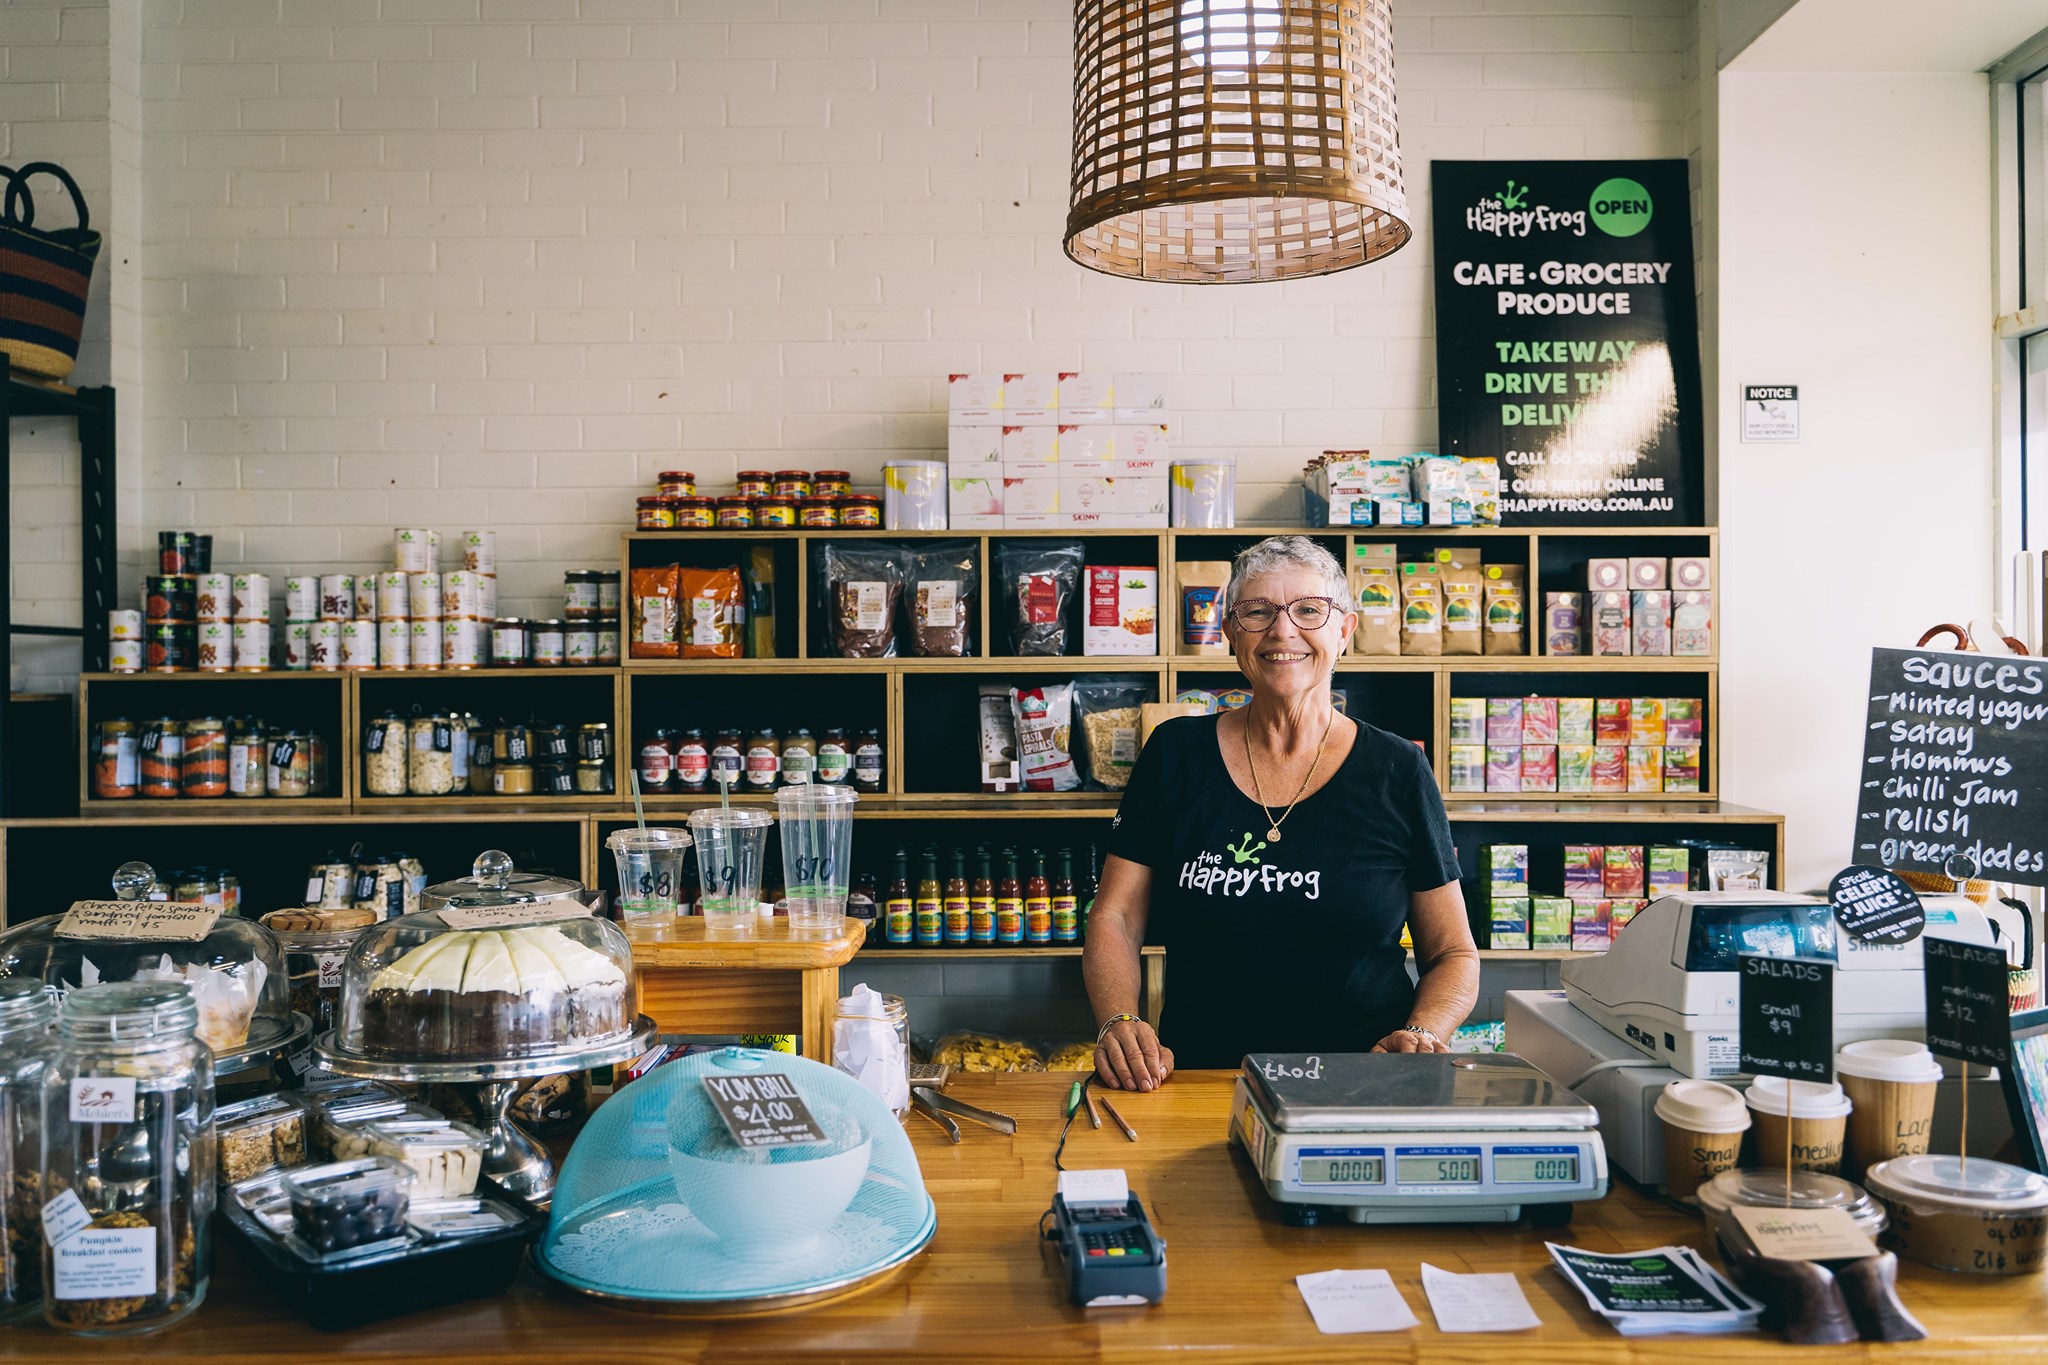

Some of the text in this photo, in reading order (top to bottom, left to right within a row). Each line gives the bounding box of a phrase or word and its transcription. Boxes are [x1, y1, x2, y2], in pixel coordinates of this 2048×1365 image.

[1479, 199, 1502, 211] the
[1594, 199, 1649, 215] OPEN
[1497, 292, 1631, 315] PRODUCE
[1495, 341, 1635, 363] TAKEWAY
[1485, 373, 1567, 394] DRIVE
[1750, 388, 1792, 398] NOTICE
[1127, 461, 1154, 469] SKINNY
[1505, 451, 1544, 465] CALL
[1511, 480, 1546, 493] OUR
[1551, 480, 1601, 493] MENU
[1603, 478, 1664, 491] ONLINE
[1889, 692, 1975, 720] Minted
[1022, 731, 1043, 744] PASTA
[1024, 740, 1052, 754] SPIRALS
[1891, 747, 2012, 776] Hommus
[1953, 780, 2018, 807] Jam
[1885, 807, 1969, 837] relish
[795, 855, 834, 881] $10
[1197, 851, 1222, 867] the
[639, 871, 671, 897] $8
[705, 866, 736, 895] $9
[1839, 870, 1874, 887] SPECIAL
[1835, 875, 1892, 904] CELERY
[1855, 893, 1899, 917] JUICE
[1926, 941, 2000, 965] SALADS
[1747, 958, 1822, 981] SALADS
[1761, 1003, 1801, 1018] small
[1942, 1002, 1976, 1022] $12
[1769, 1019, 1793, 1035] $9
[1784, 1060, 1797, 1071] up
[1799, 1060, 1812, 1071] to
[1814, 1064, 1825, 1073] 2
[708, 1076, 799, 1101] YUM BALL
[80, 1236, 122, 1244] Pumpkin
[61, 1246, 143, 1257] Breakfast cookies
